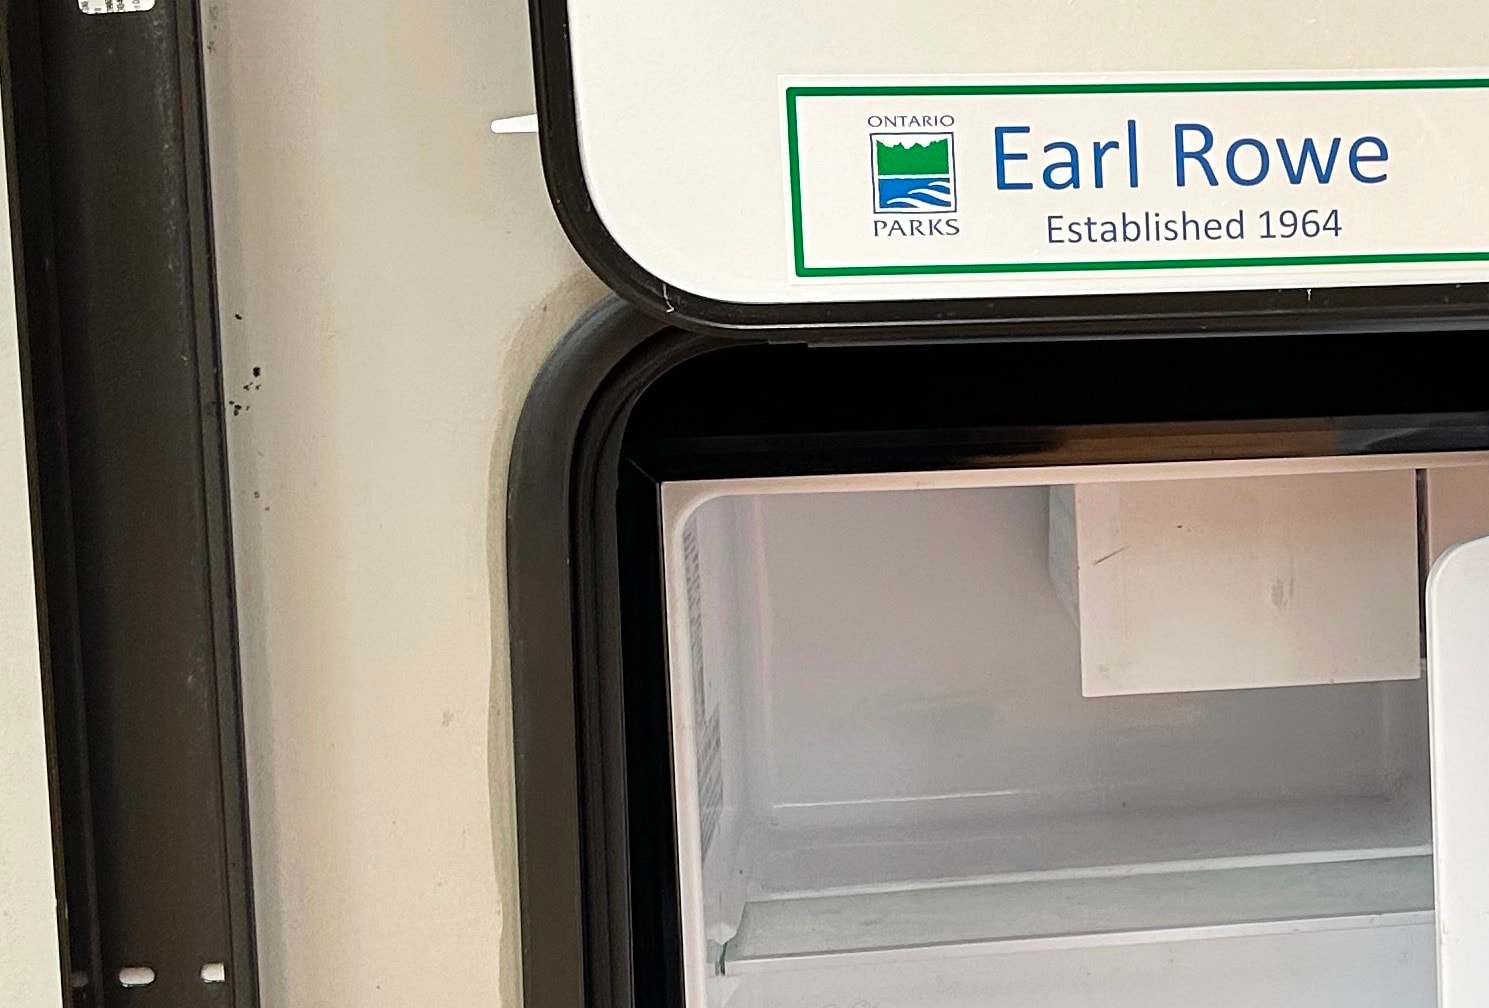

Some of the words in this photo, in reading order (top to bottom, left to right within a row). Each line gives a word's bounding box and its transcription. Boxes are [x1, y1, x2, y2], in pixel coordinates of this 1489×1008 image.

[867, 114, 955, 128] ONTARIO
[994, 120, 1141, 192] Earl
[1173, 122, 1390, 187] Rowe
[873, 218, 961, 237] PARKS
[1047, 209, 1245, 245] Established
[1258, 208, 1343, 239] 1964
